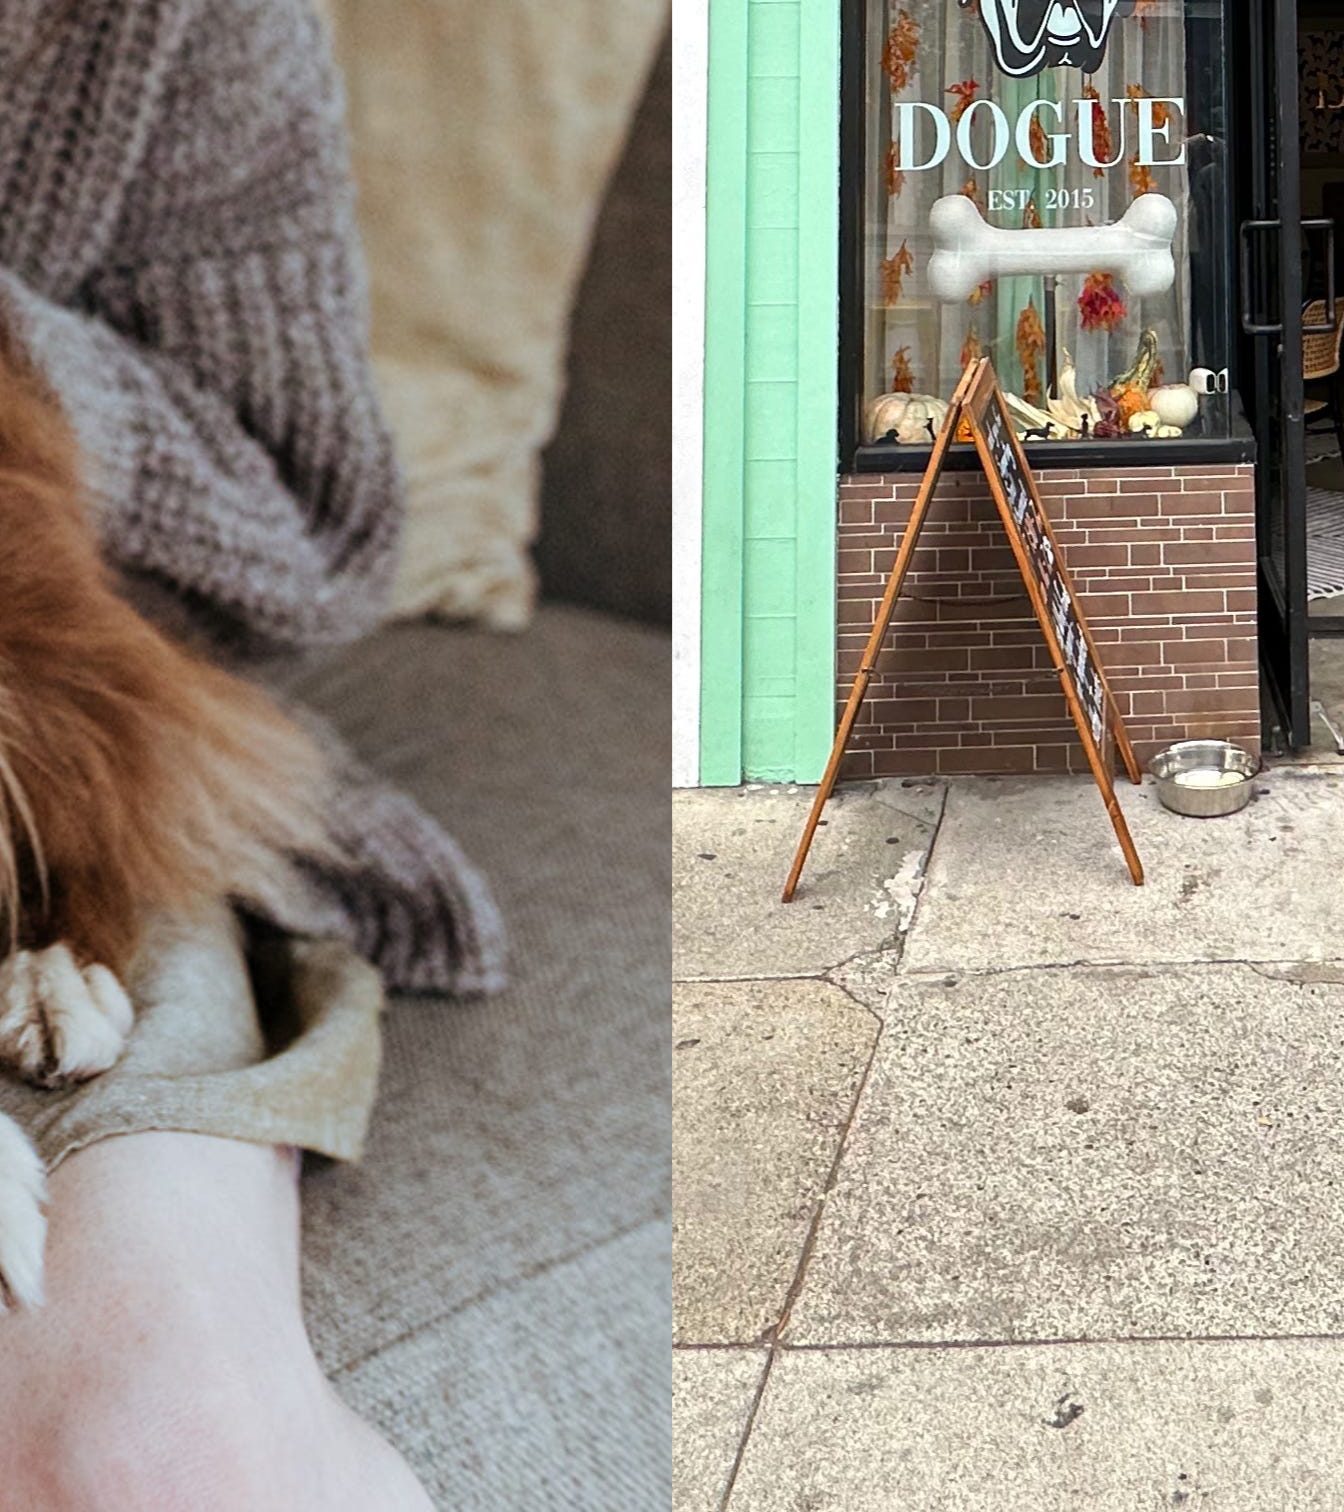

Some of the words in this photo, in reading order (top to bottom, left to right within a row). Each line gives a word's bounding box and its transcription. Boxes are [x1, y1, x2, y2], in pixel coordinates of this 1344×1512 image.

[894, 98, 1185, 171] DOGUE
[987, 188, 1035, 212] EST.
[1045, 187, 1094, 210] 2015
